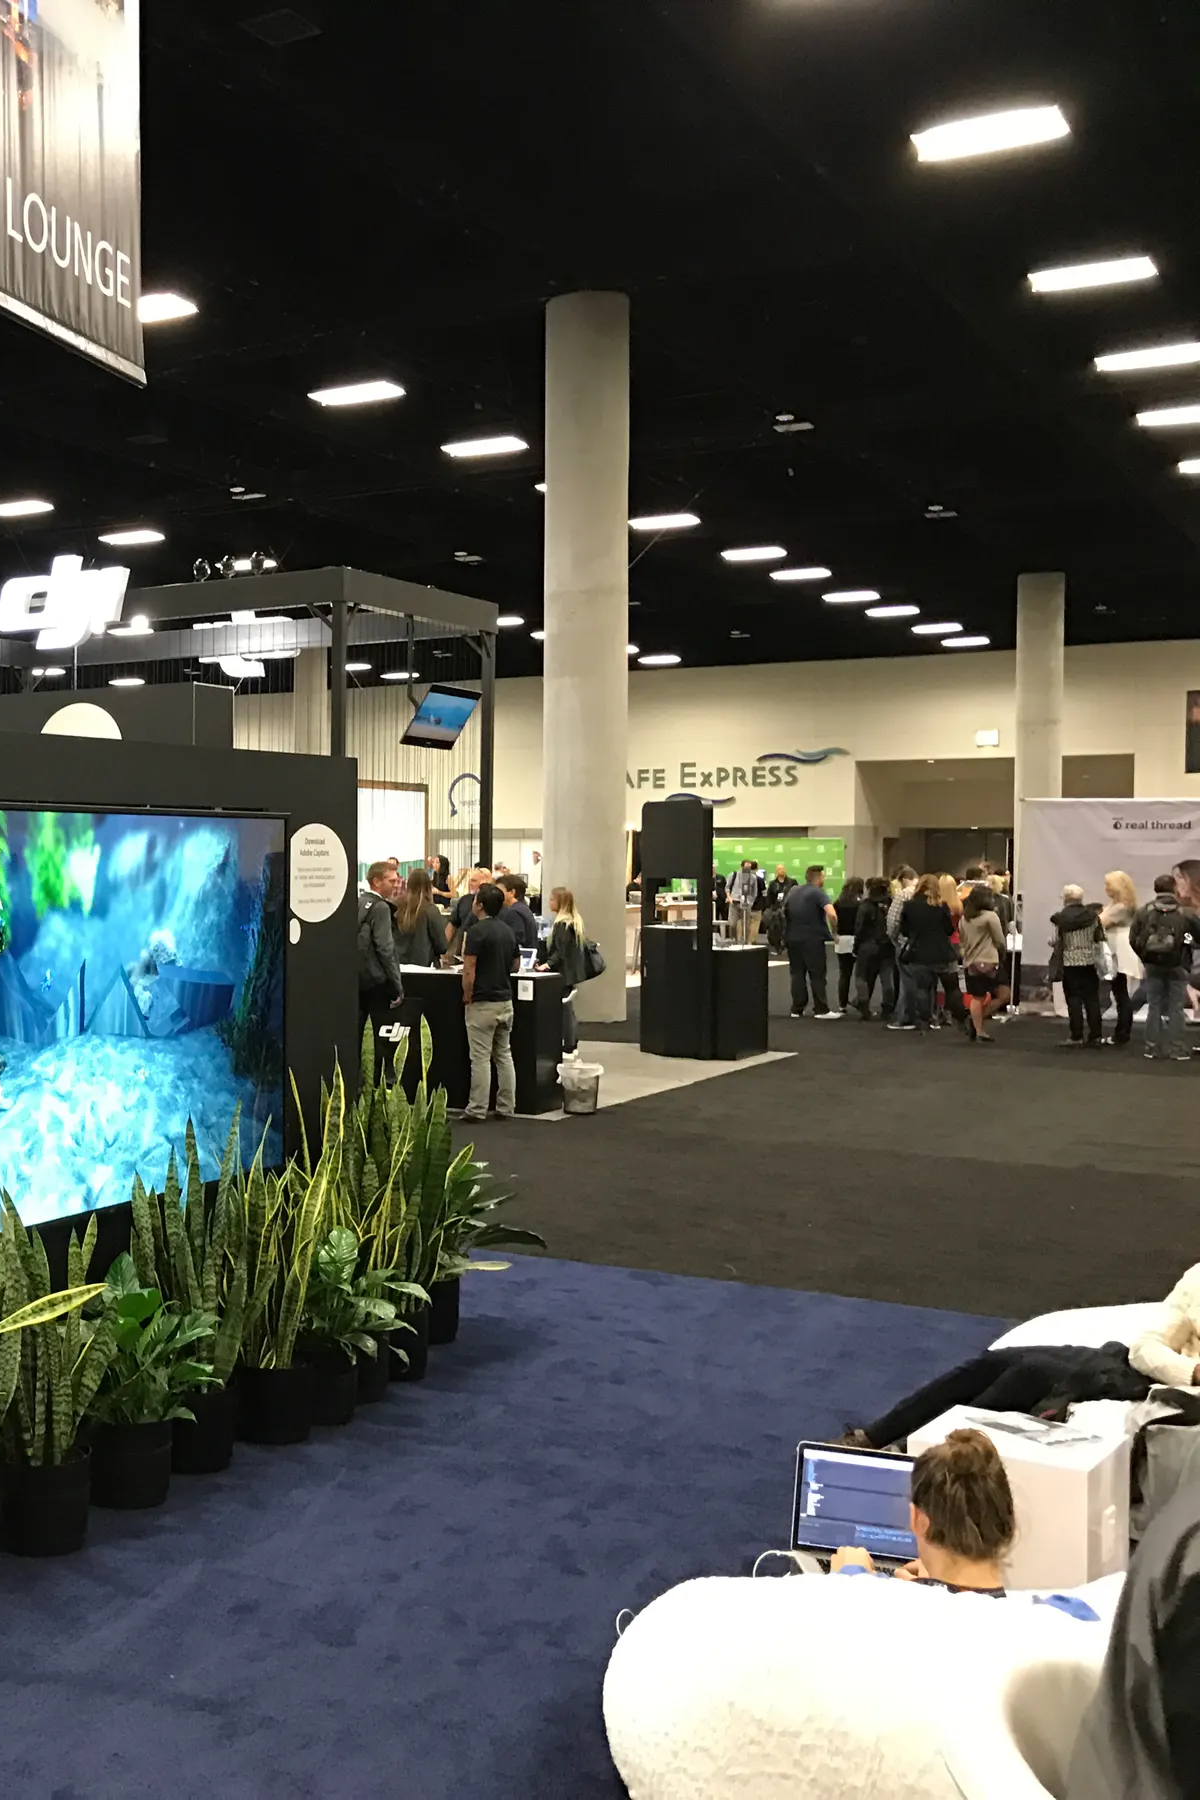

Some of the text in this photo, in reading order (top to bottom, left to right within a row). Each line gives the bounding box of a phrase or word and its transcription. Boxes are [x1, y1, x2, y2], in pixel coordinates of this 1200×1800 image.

[6, 176, 131, 309] LOUNGE
[1125, 820, 1192, 830] real thread
